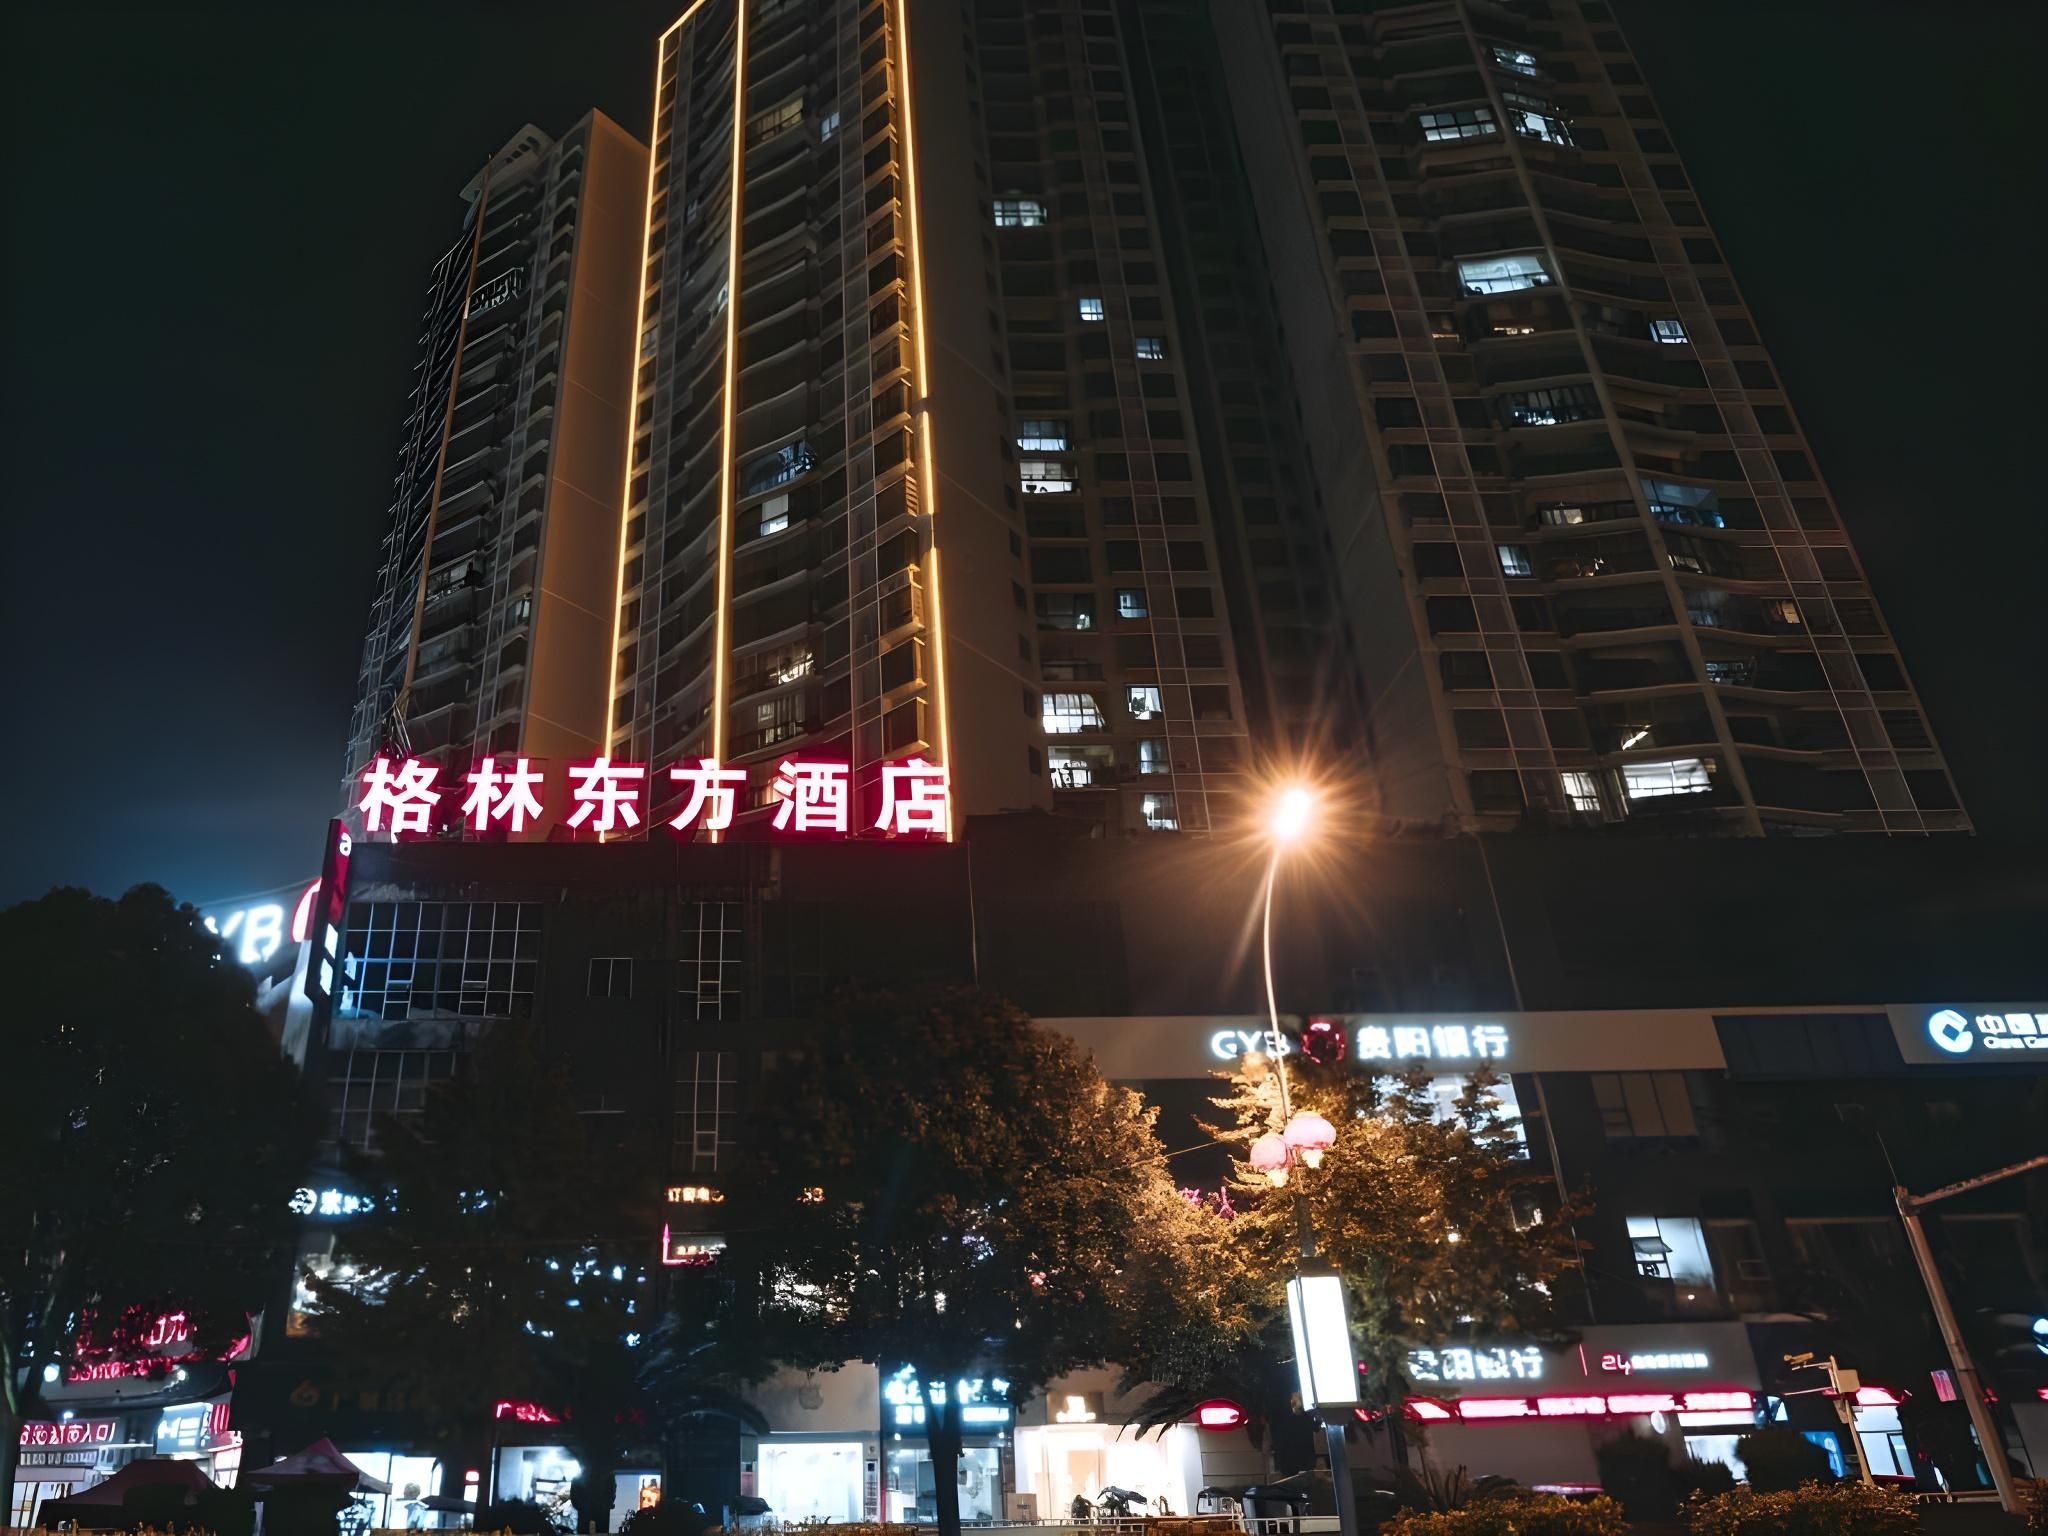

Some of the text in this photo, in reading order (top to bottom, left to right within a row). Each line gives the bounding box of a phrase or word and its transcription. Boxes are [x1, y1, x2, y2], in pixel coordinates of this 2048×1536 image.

[358, 757, 946, 834] 格林东方酒店
[1357, 1025, 1509, 1059] 贵阳银行
